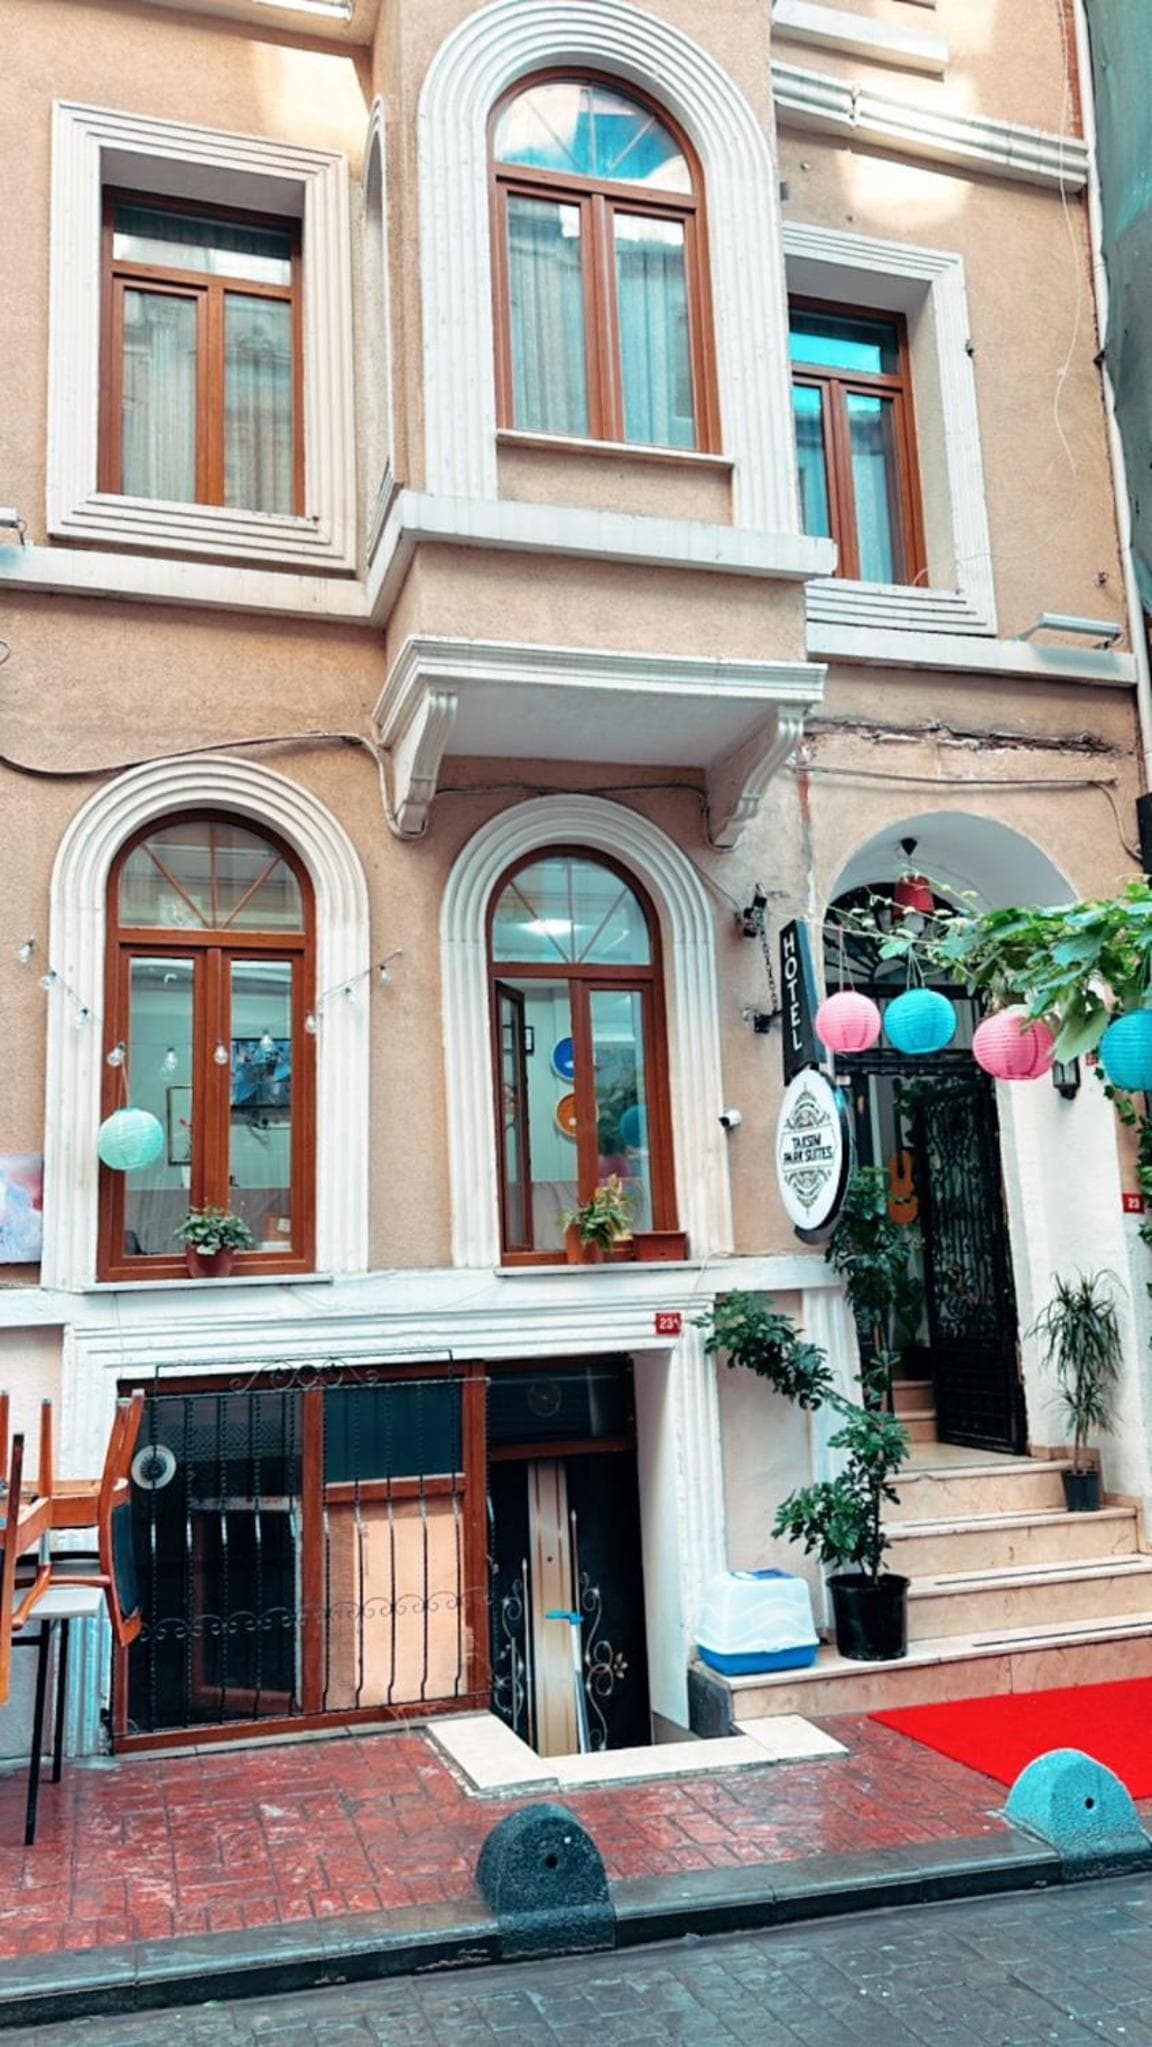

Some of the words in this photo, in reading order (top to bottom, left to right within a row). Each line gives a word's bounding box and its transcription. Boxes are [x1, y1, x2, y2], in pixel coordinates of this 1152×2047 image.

[783, 931, 803, 1051] HOTEL
[783, 1151, 803, 1163] PARK
[805, 1145, 833, 1162] SUITES
